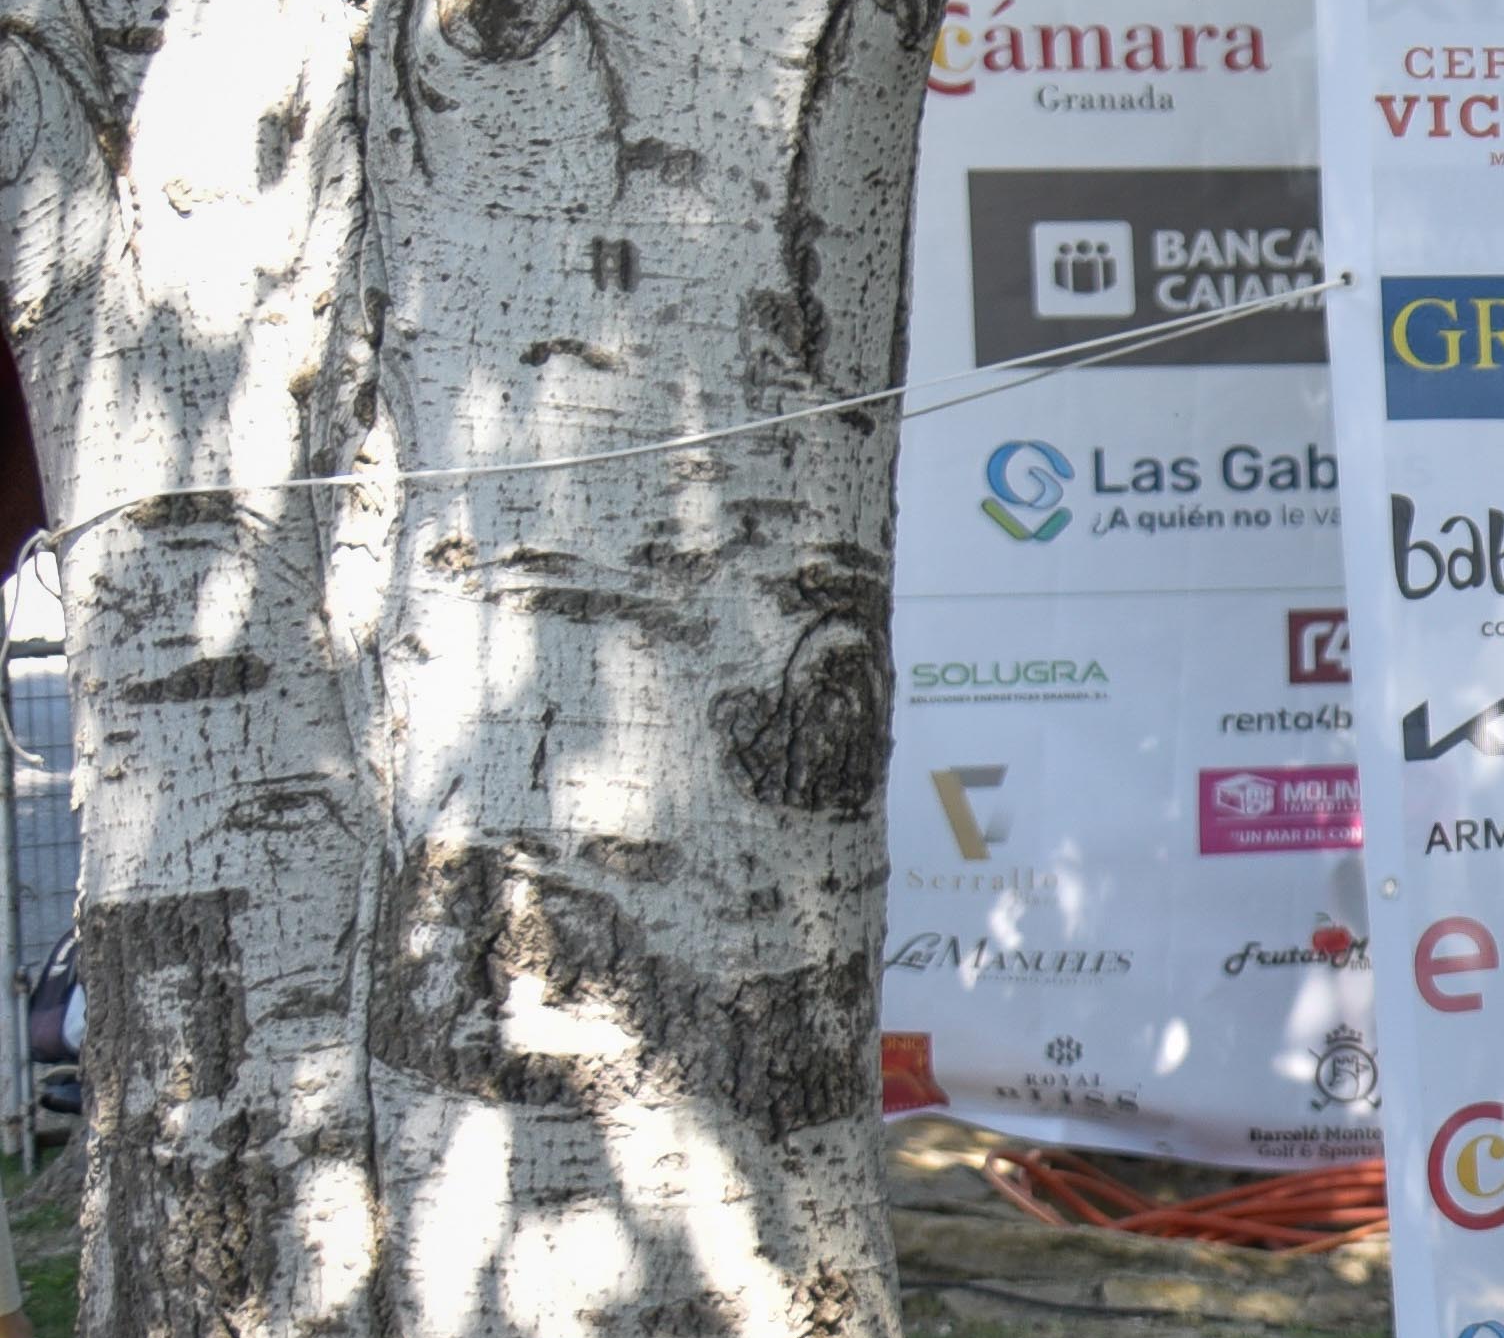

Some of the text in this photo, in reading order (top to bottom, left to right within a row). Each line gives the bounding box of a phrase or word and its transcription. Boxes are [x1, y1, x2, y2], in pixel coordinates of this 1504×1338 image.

[1034, 84, 1176, 112] Granada
[1091, 444, 1339, 495] Las Gab
[1136, 502, 1226, 532] quién
[1232, 507, 1272, 528] no
[1280, 504, 1305, 527] le
[911, 659, 1111, 689] SOLUGRA
